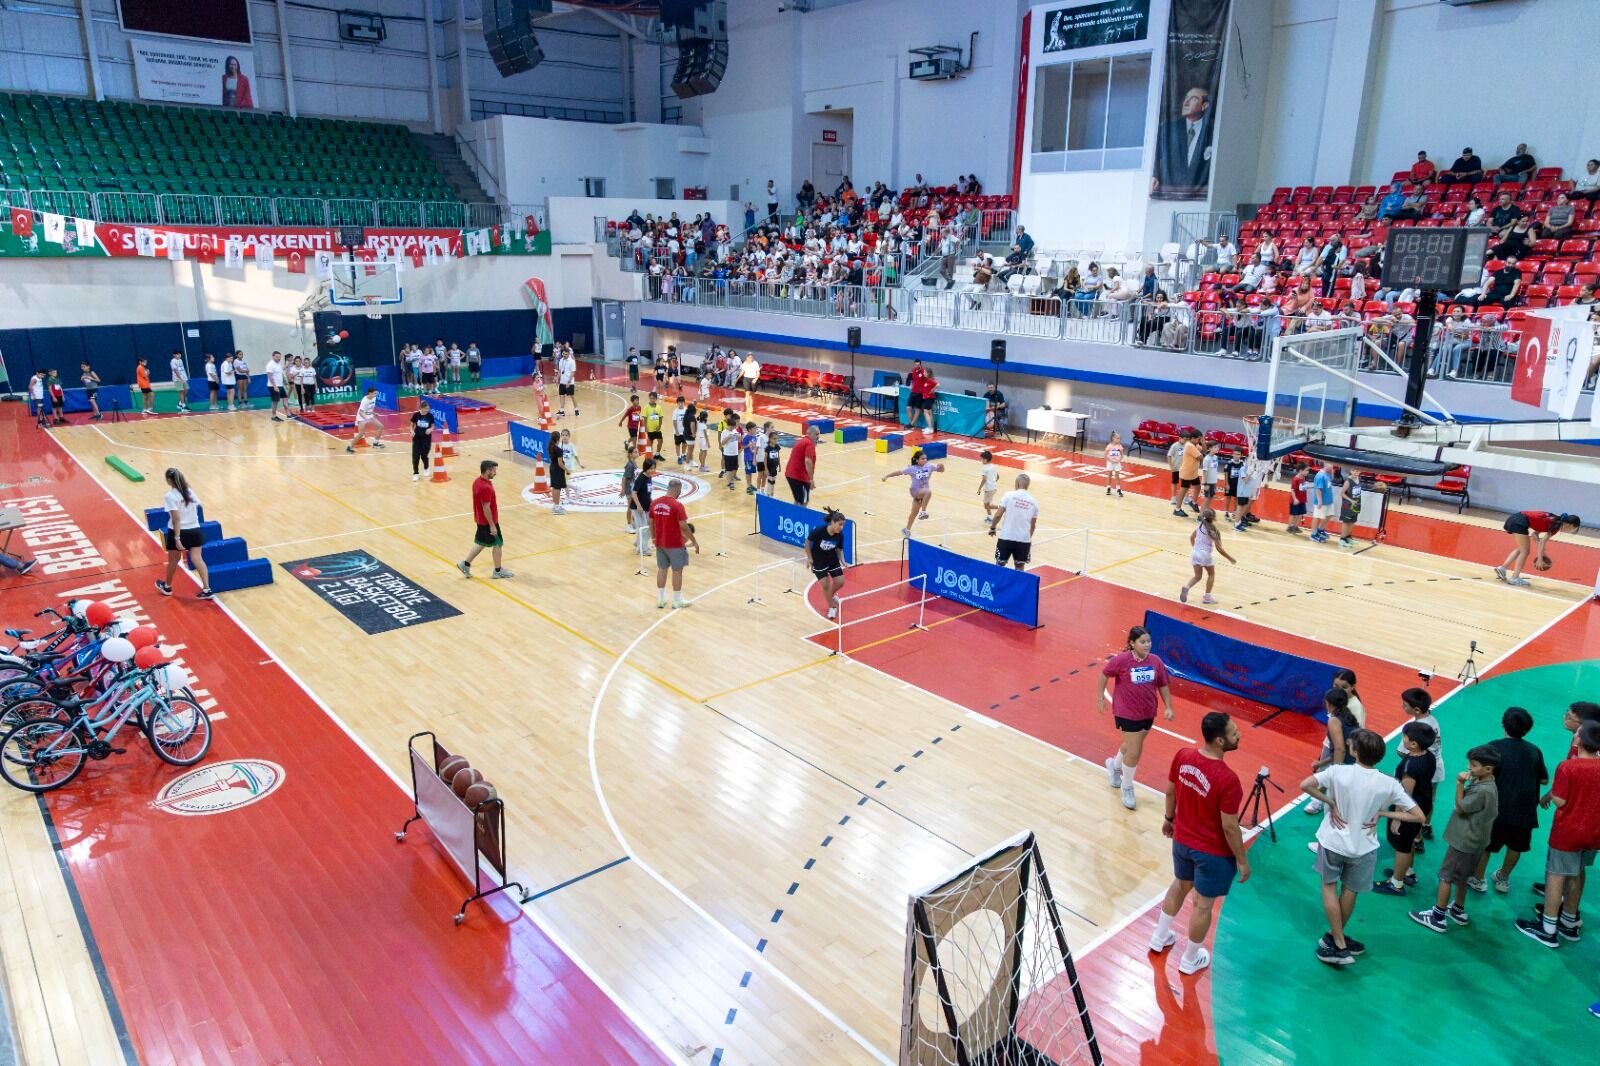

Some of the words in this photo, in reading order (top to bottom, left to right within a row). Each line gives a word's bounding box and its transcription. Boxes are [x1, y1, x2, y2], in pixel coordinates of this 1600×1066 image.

[777, 515, 810, 540] JOOL
[344, 576, 422, 625] BASKETBOL
[371, 572, 431, 606] TÜRKİYE
[935, 566, 994, 601] JOOLA
[1136, 674, 1151, 682] 059
